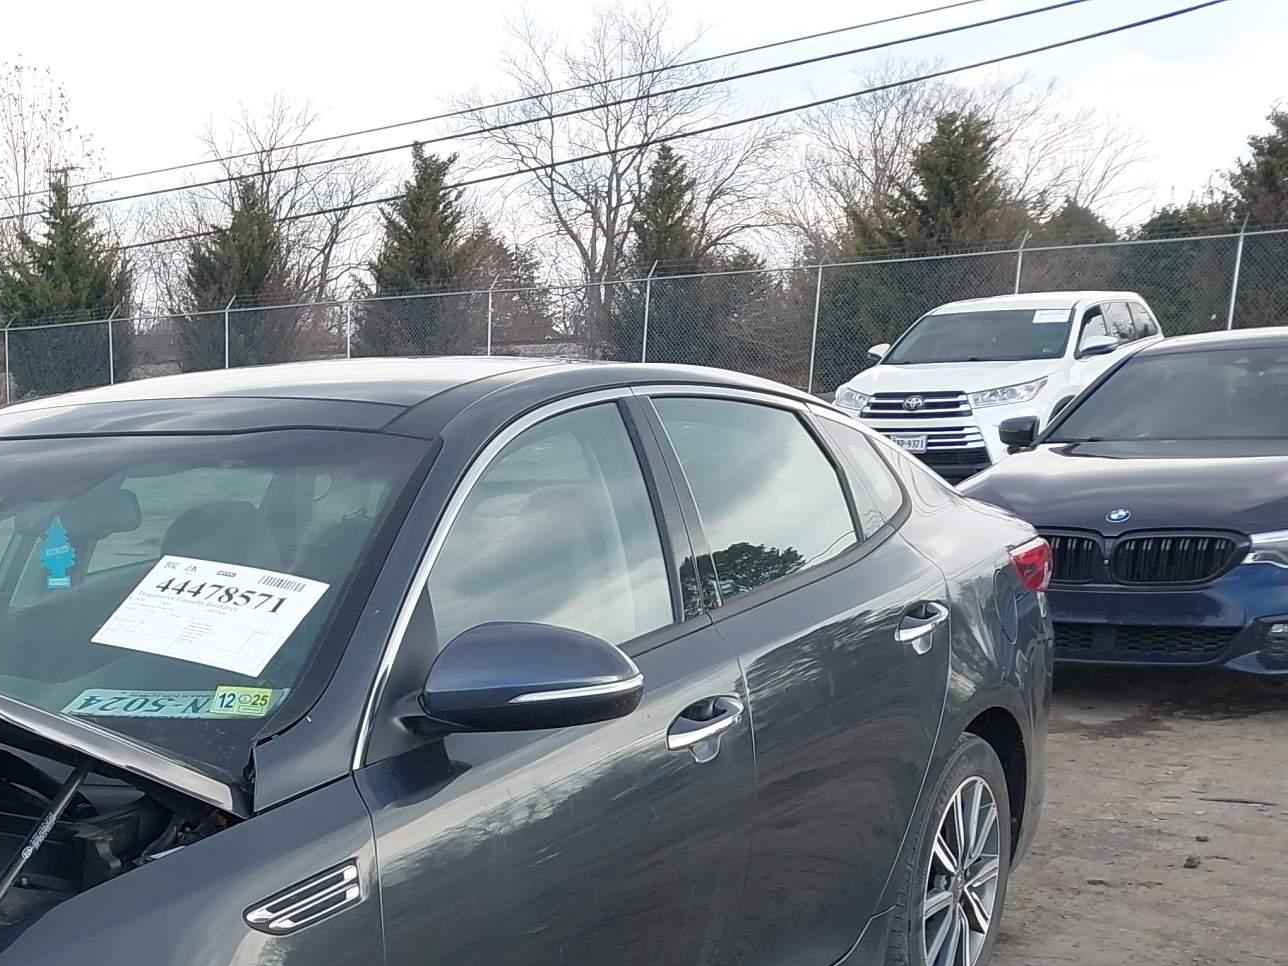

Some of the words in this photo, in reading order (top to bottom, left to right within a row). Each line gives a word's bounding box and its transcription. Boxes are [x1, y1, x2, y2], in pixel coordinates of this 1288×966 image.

[156, 577, 287, 613] 44478571
[77, 695, 212, 713] N-5024
[219, 693, 236, 708] 12
[251, 695, 268, 706] 25
